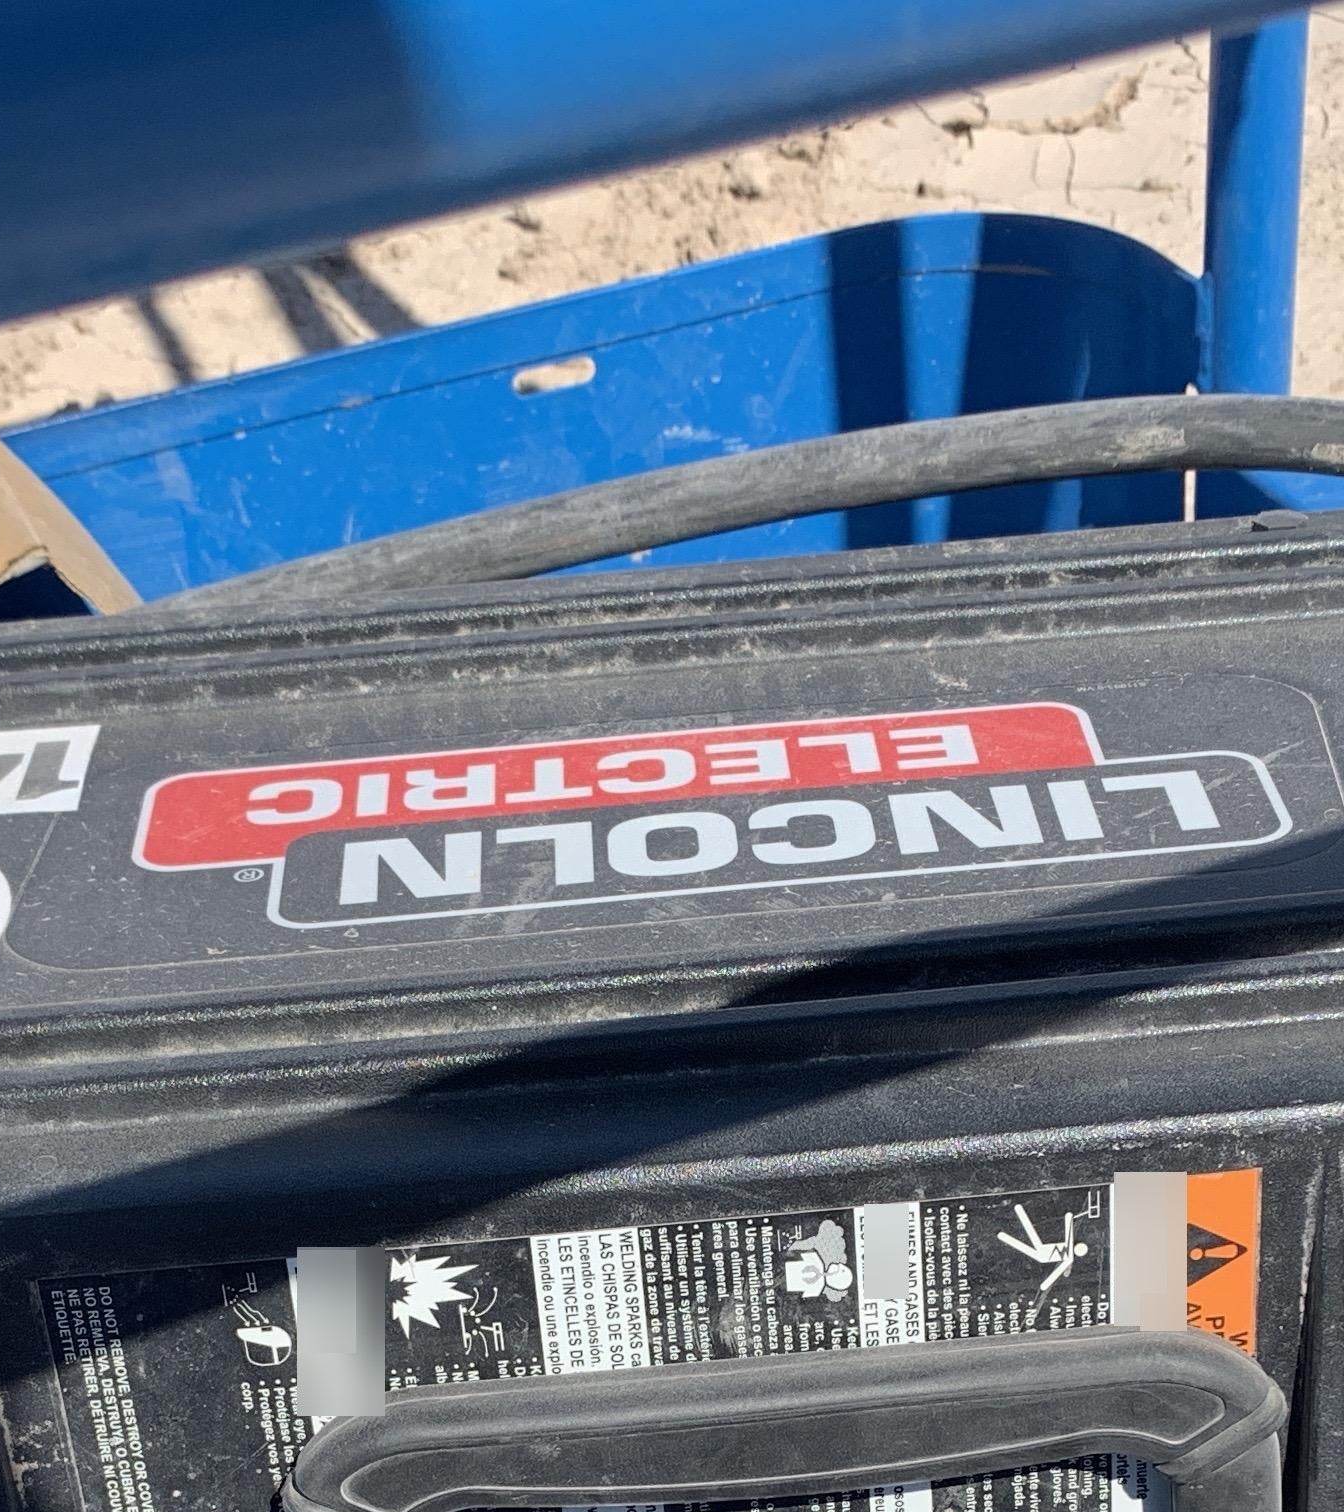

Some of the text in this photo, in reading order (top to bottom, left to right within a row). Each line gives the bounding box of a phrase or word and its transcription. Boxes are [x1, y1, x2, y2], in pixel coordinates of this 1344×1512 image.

[246, 724, 981, 828] ELECTRIC
[338, 769, 1222, 906] LINCOLN
[725, 1221, 739, 1248] para
[938, 1207, 952, 1252] contact
[955, 1213, 967, 1231] Ne
[557, 1237, 573, 1262] LES
[598, 1233, 613, 1259] LAS
[640, 1228, 653, 1250] gaz
[657, 1226, 673, 1280] suffisant
[691, 1232, 704, 1263] Tenir
[744, 1227, 757, 1251] Use
[537, 1238, 555, 1291] incendie
[618, 1231, 637, 1293] WELDING
[644, 1253, 656, 1268] de
[675, 1233, 689, 1278] Utiliser
[711, 1222, 729, 1301] área general.
[921, 1216, 939, 1318] Isolez-vous de la
[955, 1233, 970, 1275] laissez
[646, 1271, 657, 1282] la
[694, 1266, 705, 1277] la
[730, 1250, 745, 1300] eliminar
[941, 1255, 951, 1285] avec
[958, 1279, 970, 1290] ni
[66, 1287, 81, 1308] NE
[81, 1286, 97, 1308] NO
[97, 1284, 113, 1306] DO
[577, 1235, 604, 1366] incendio o explosión.
[601, 1262, 619, 1319] CHISPAS
[647, 1285, 658, 1315] zone
[663, 1283, 673, 1298] au
[679, 1280, 689, 1295] un
[695, 1279, 707, 1303] tête
[746, 1254, 762, 1320] ventilación
[758, 1225, 780, 1349] Mantenga su cabeza
[942, 1288, 955, 1309] des
[958, 1293, 970, 1304] la
[543, 1295, 555, 1310] ou
[560, 1265, 581, 1346] ETINCELLES
[734, 1303, 747, 1321] los
[863, 1302, 877, 1318] ET
[903, 1292, 920, 1336] GASES
[1025, 1309, 1036, 1325] No
[1096, 1301, 1109, 1319] Do
[70, 1308, 87, 1336] PAS
[102, 1307, 119, 1337] NOT
[545, 1315, 558, 1337] une
[607, 1323, 621, 1341] DE
[624, 1296, 642, 1349] SPARKS
[650, 1317, 662, 1333] de
[664, 1302, 678, 1342] niveau
[677, 1299, 695, 1350] système
[752, 1324, 761, 1332] o
[798, 1322, 811, 1351] from
[813, 1321, 825, 1344] arc,
[956, 1308, 969, 1337] peau
[85, 1309, 111, 1376] REMUEVA,
[669, 1345, 680, 1360] de
[734, 1325, 748, 1358] gases
[830, 1327, 843, 1350] Use
[76, 1337, 99, 1397] RETIRER,
[107, 1337, 131, 1397] REMOVE,
[570, 1349, 583, 1367] DE
[99, 1377, 125, 1445] DESTRUYA
[255, 1387, 277, 1441] Protégez
[267, 1442, 279, 1464] vos
[271, 1386, 293, 1443] Protéjase
[282, 1444, 296, 1463] los
[88, 1398, 115, 1462] DÉTRUIRE
[119, 1398, 143, 1458] DESTROY
[292, 1418, 307, 1443] eye,
[114, 1446, 127, 1458] O
[102, 1463, 116, 1479] NI
[117, 1459, 136, 1504] CUBRA
[133, 1459, 147, 1480] OR
[1067, 1468, 1078, 1488] and
[1049, 1466, 1064, 1506] gloves.
[1095, 1470, 1110, 1499] parts
